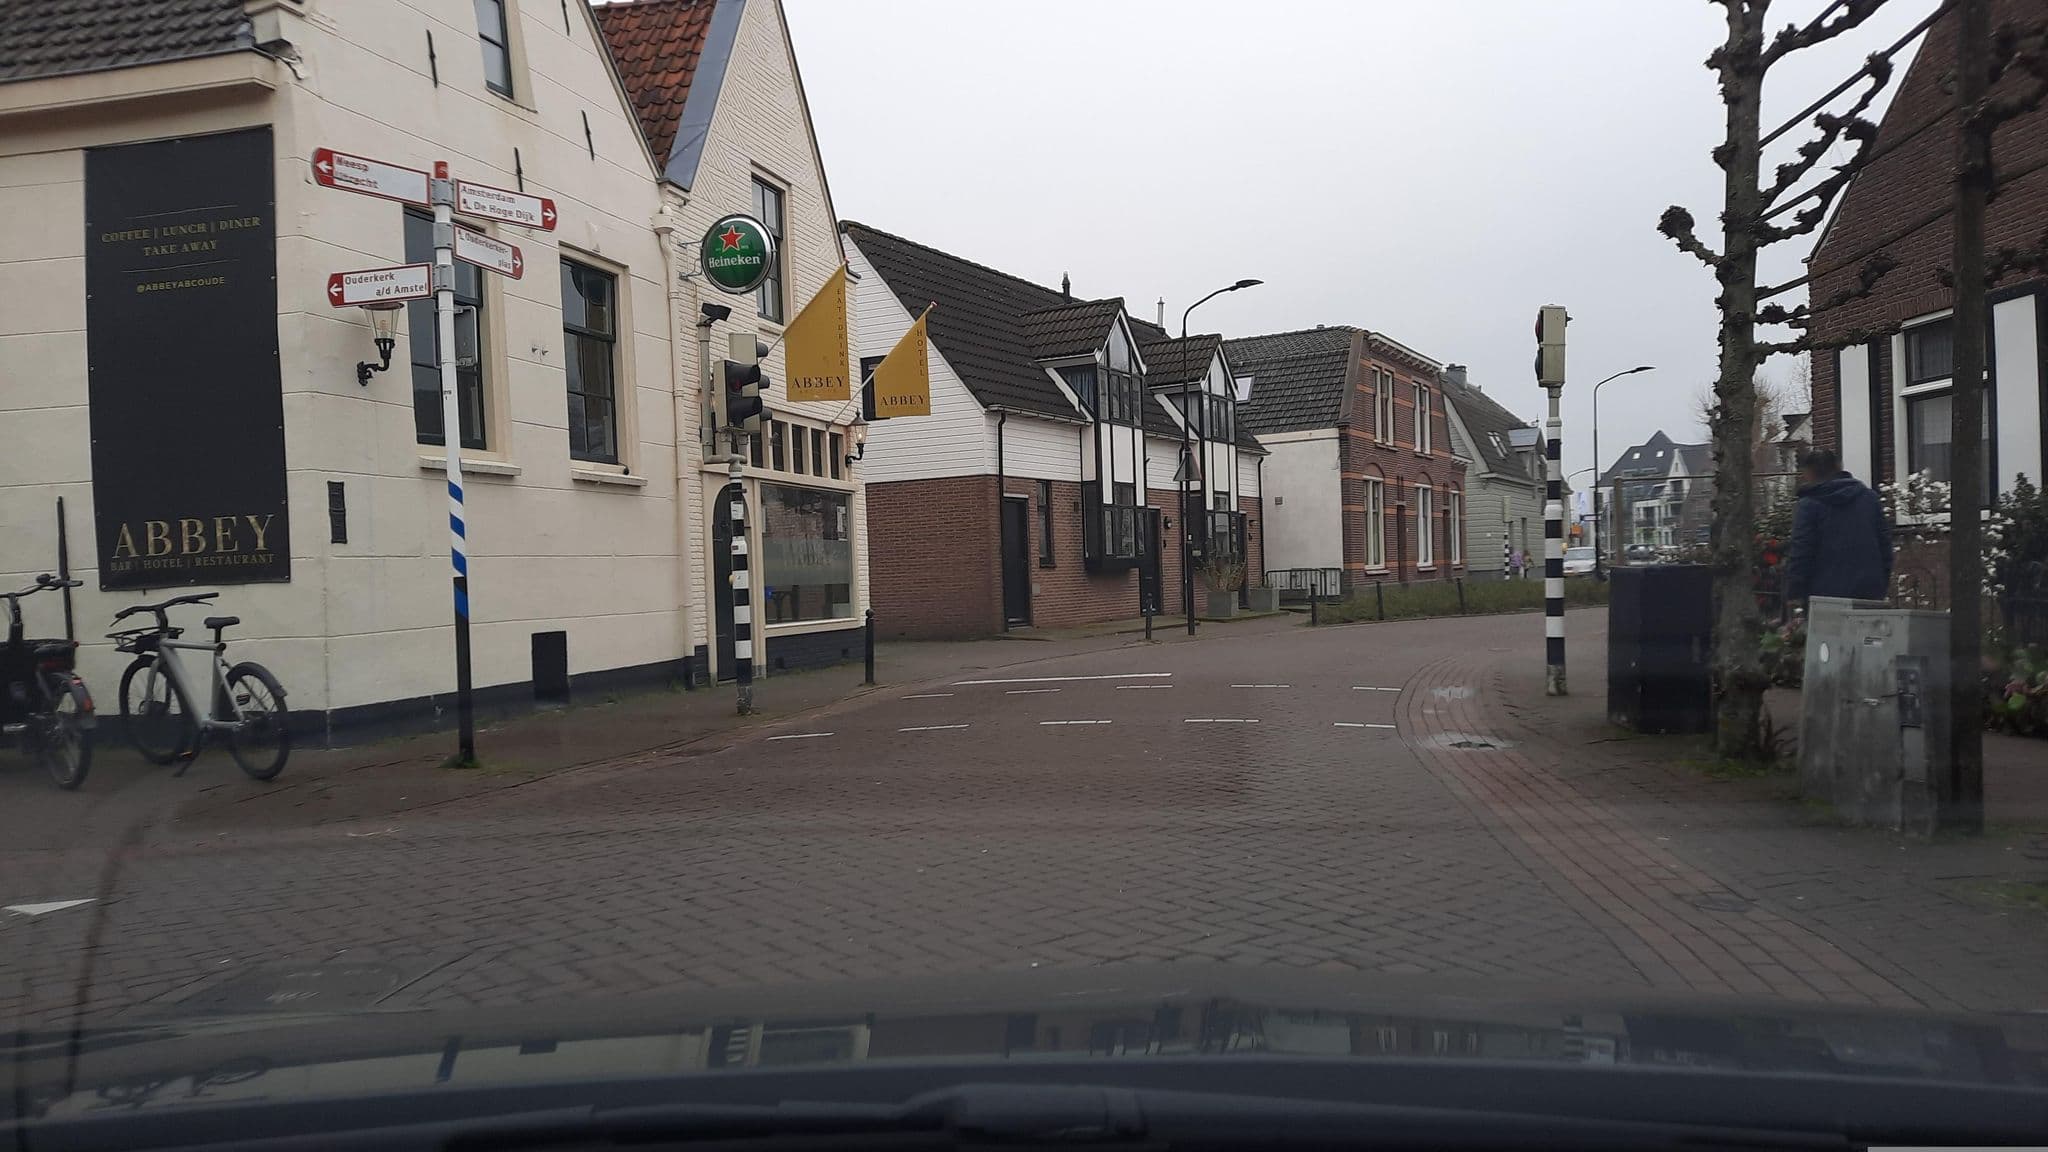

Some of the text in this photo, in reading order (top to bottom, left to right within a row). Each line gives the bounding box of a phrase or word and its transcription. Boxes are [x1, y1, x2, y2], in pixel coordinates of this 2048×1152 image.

[334, 155, 369, 172] Weesp
[461, 186, 516, 204] Amsterdam
[473, 201, 535, 222] De Hoge Dijk
[101, 216, 262, 243] COFFEE LUNCH DINER
[143, 240, 218, 257] TAKE AWAY
[498, 259, 511, 270] plas
[708, 254, 761, 268] Heineken
[136, 276, 225, 293] @ABBEYABCOUDE
[344, 272, 395, 285] Ouderkerk
[375, 282, 427, 297] a/d Amstel
[916, 328, 925, 377] HOTEL
[791, 375, 845, 389] ABBEY
[880, 394, 925, 406] ABBEY
[111, 514, 275, 559] ABBEY
[111, 553, 275, 571] BAR HOTEL RESTAURANT
